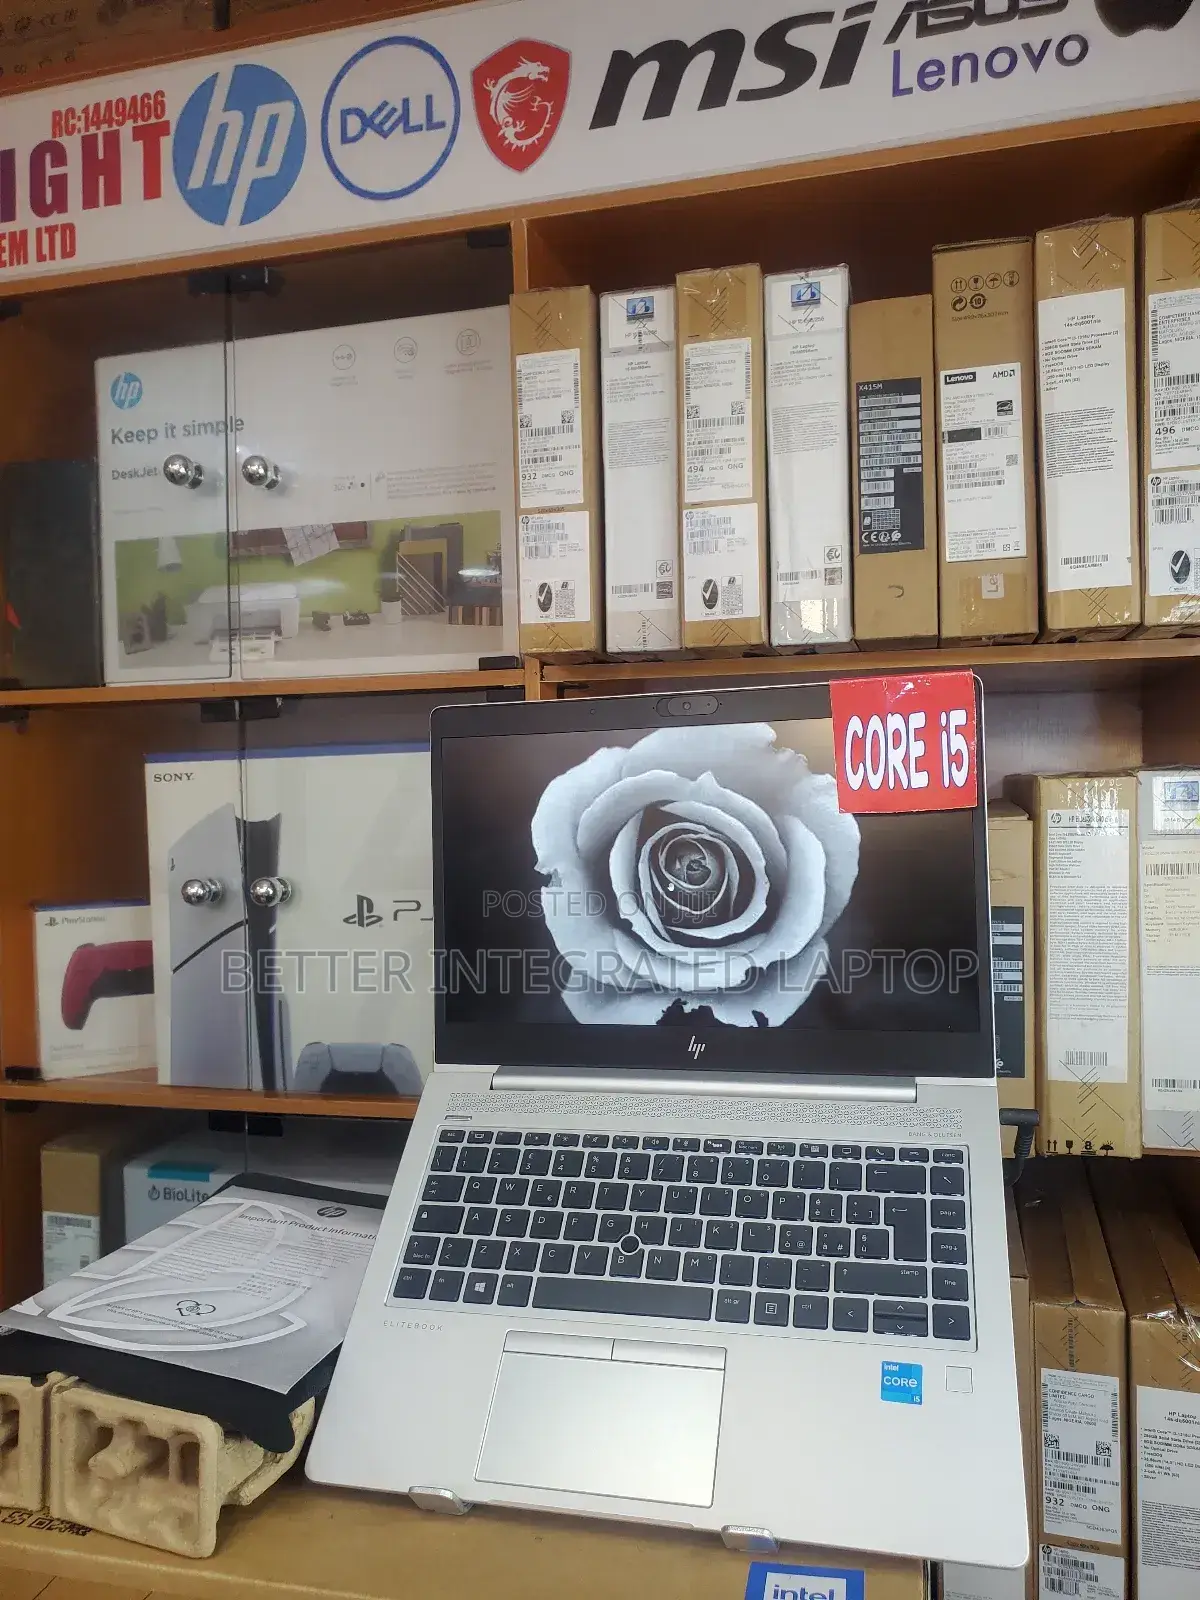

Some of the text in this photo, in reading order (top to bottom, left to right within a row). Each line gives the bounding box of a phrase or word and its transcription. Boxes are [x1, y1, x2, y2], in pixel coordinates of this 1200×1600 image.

[589, 0, 877, 130] msi
[892, 34, 1089, 98] Lenovo
[51, 90, 166, 139] RC:1449466
[340, 94, 446, 146] DELL
[36, 222, 76, 262] LTD
[946, 374, 974, 384] Lenovo
[992, 371, 1010, 379] AMD
[111, 372, 143, 409] hp
[859, 383, 883, 392] X415M
[110, 415, 246, 446] Keep it simple
[1155, 426, 1176, 436] 496
[111, 467, 159, 481] DeskJet
[522, 473, 538, 481] 932
[687, 465, 705, 474] 494
[844, 708, 971, 792] CORE i5
[153, 771, 193, 783] SONY
[659, 1168, 664, 1176] 7
[163, 1186, 210, 1203] BioLite
[472, 1182, 481, 1190] Q
[505, 1183, 516, 1191] W
[537, 1185, 543, 1193] E
[569, 1186, 577, 1195] R
[603, 1188, 610, 1196] T
[638, 1189, 646, 1198] Y
[672, 1191, 680, 1199] U
[743, 1195, 752, 1203] O
[779, 1197, 786, 1205] P
[239, 1214, 287, 1226] Important
[288, 1222, 328, 1233] Product
[472, 1213, 480, 1221] A
[505, 1214, 513, 1223] S
[571, 1218, 578, 1226] F
[607, 1219, 615, 1228] G
[641, 1222, 649, 1230] H
[676, 1224, 682, 1232] J
[713, 1226, 720, 1235] K
[750, 1229, 756, 1237] L
[480, 1246, 700, 1267] Z X C V B N M
[900, 1269, 920, 1277] stamp
[944, 1279, 957, 1287] fine
[383, 1320, 444, 1333] ELITEBOOK
[884, 1364, 900, 1372] intel
[913, 1395, 921, 1403] i5
[1045, 1496, 1065, 1507] 932
[1092, 1504, 1111, 1513] ONG
